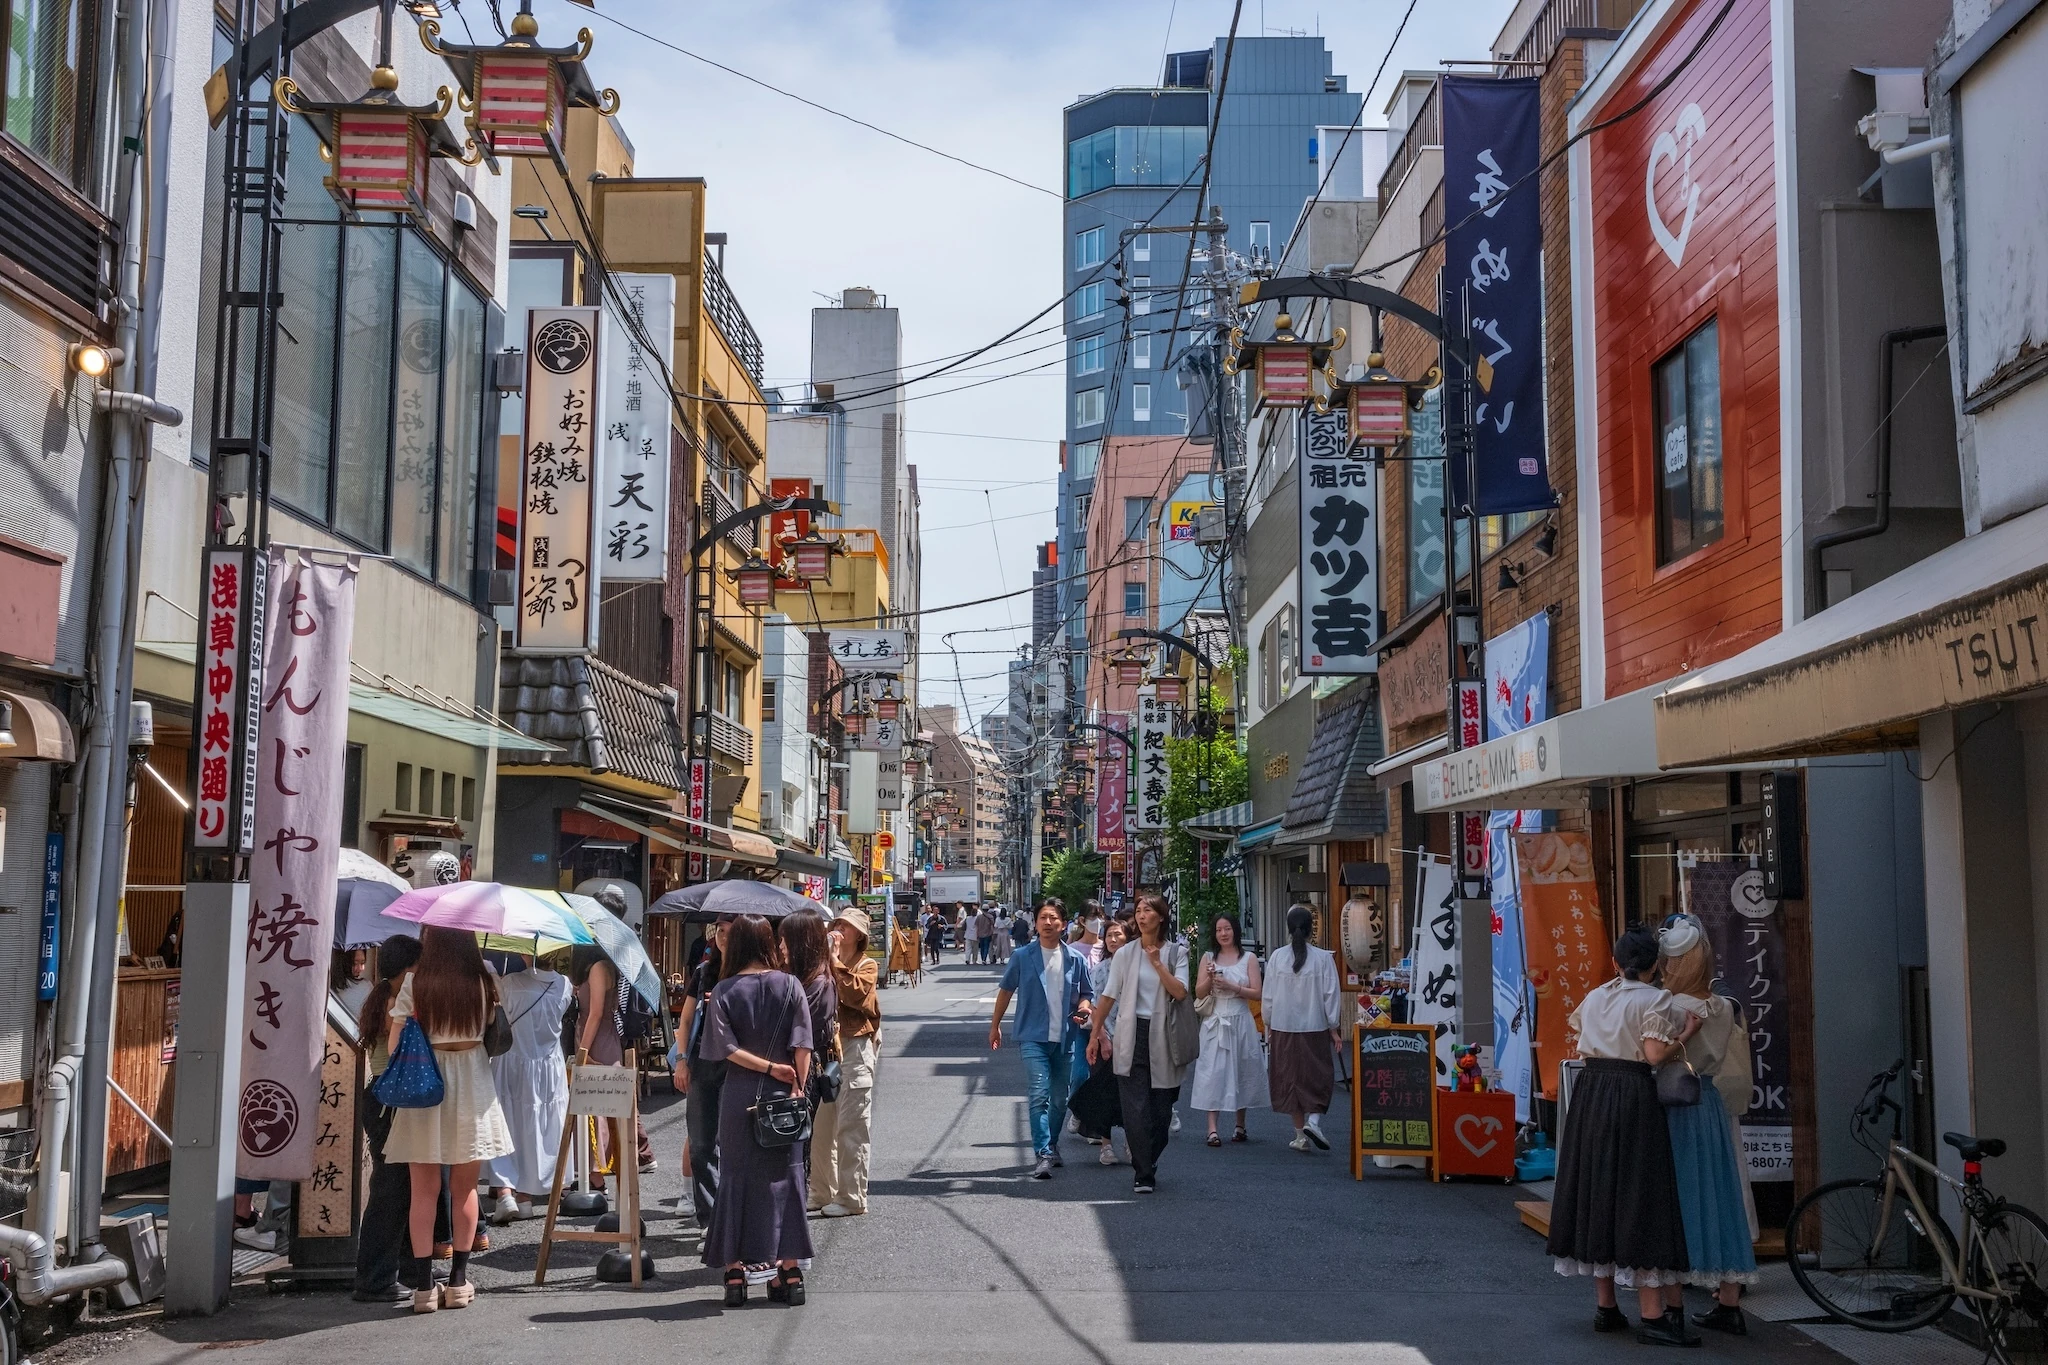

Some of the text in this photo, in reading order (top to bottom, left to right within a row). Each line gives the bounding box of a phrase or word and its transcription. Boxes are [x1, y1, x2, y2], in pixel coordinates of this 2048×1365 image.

[556, 389, 588, 484] お好み焼
[607, 422, 656, 461] 浅草
[1671, 452, 1684, 467] cafe
[528, 441, 558, 516] 鉄板焼
[608, 473, 654, 562] 天彩
[1309, 495, 1373, 658] カツ吉
[250, 560, 266, 670] ASAKUSA
[199, 563, 237, 838] 浅草中央通り
[247, 677, 260, 743] CHUO
[244, 749, 256, 807] DORI
[1442, 758, 1474, 799] BELLE
[1481, 746, 1519, 790] EMMA
[1764, 804, 1775, 885] OPEN
[41, 971, 55, 989] 20
[1568, 889, 1593, 999] ふわもちパン
[1744, 922, 1773, 1079] テイクアウト
[1371, 1038, 1419, 1052] WELCOME
[312, 1040, 346, 1234] お好み焼き
[1385, 1133, 1400, 1142] OK
[1408, 1123, 1426, 1133] FREE
